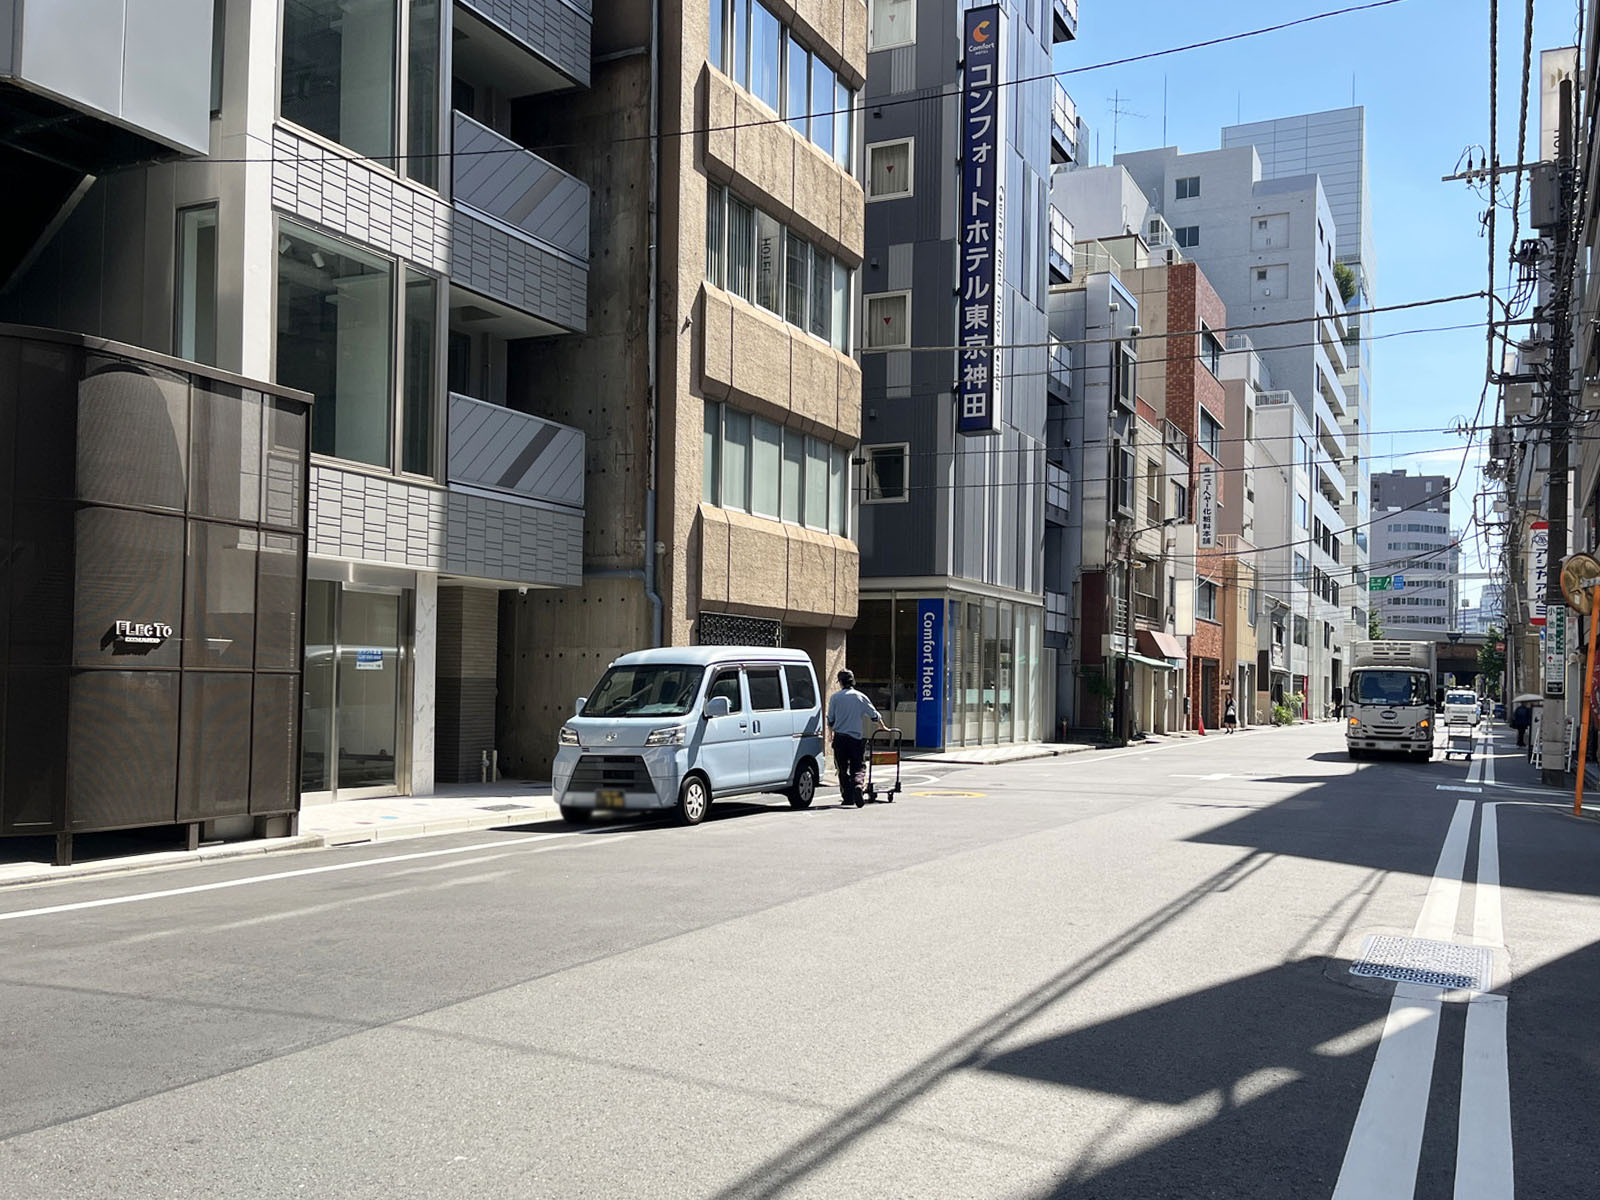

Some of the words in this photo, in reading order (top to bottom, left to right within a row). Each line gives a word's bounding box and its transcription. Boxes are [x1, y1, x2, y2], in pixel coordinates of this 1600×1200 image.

[968, 42, 995, 52] Comfort
[964, 64, 991, 418] コンフォートホテル東京神田
[922, 612, 935, 664] Comfort
[922, 666, 934, 701] Hotel
